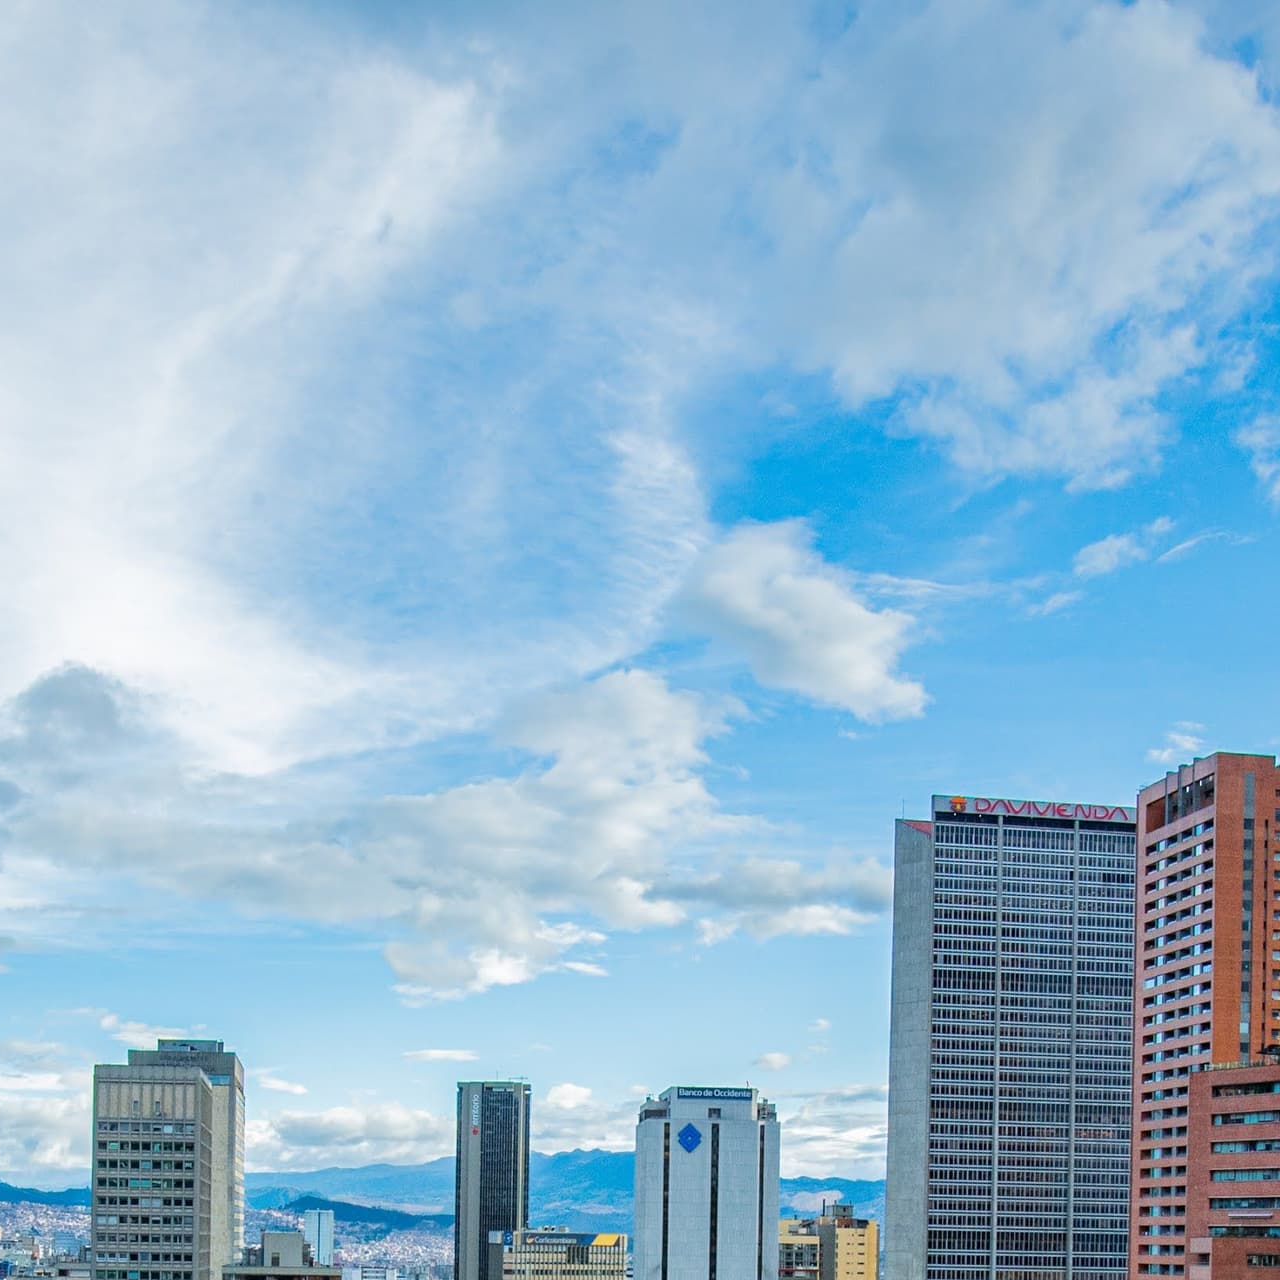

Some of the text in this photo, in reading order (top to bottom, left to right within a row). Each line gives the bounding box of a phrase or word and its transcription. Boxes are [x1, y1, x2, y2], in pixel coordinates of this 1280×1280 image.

[974, 798, 1128, 821] DAVIVIENDA
[679, 1088, 751, 1097] Banco de Occidente
